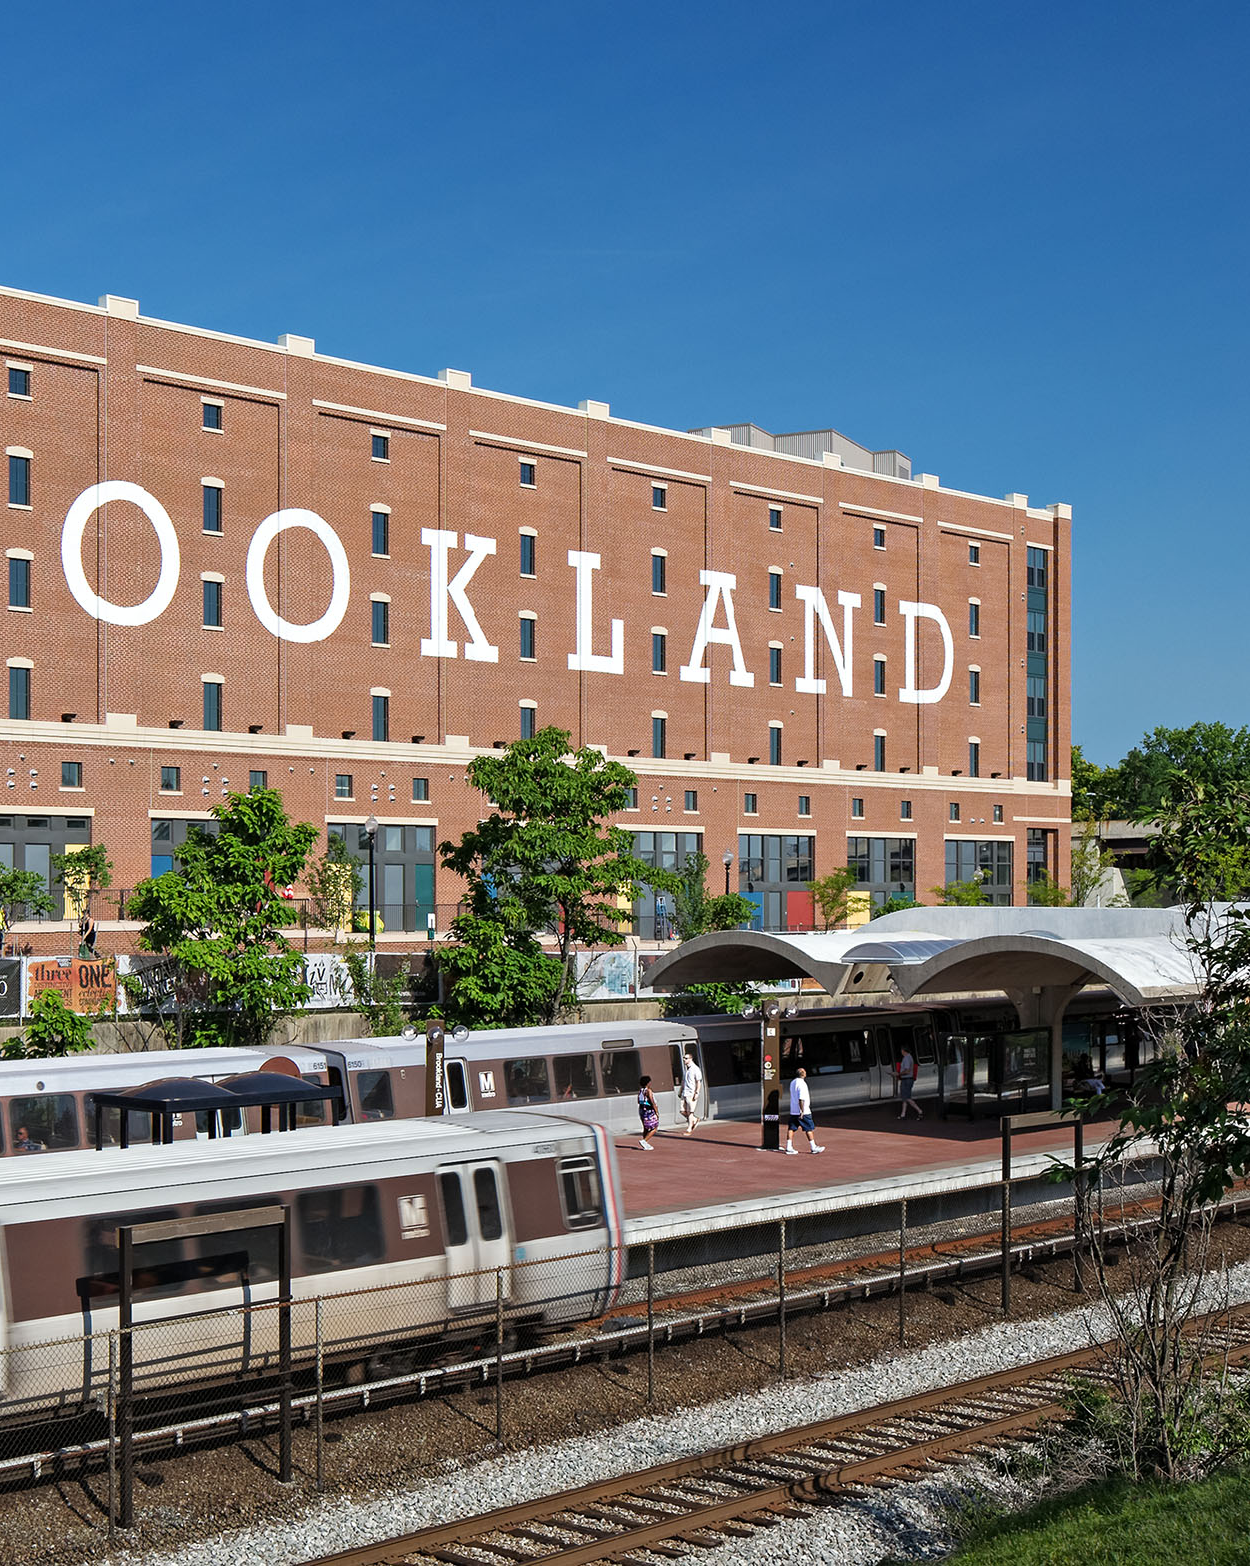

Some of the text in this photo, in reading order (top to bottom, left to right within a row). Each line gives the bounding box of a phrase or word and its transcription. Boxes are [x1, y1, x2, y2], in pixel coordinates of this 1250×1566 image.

[35, 964, 72, 981] three
[79, 965, 111, 988] ONE
[313, 1062, 326, 1070] 6151
